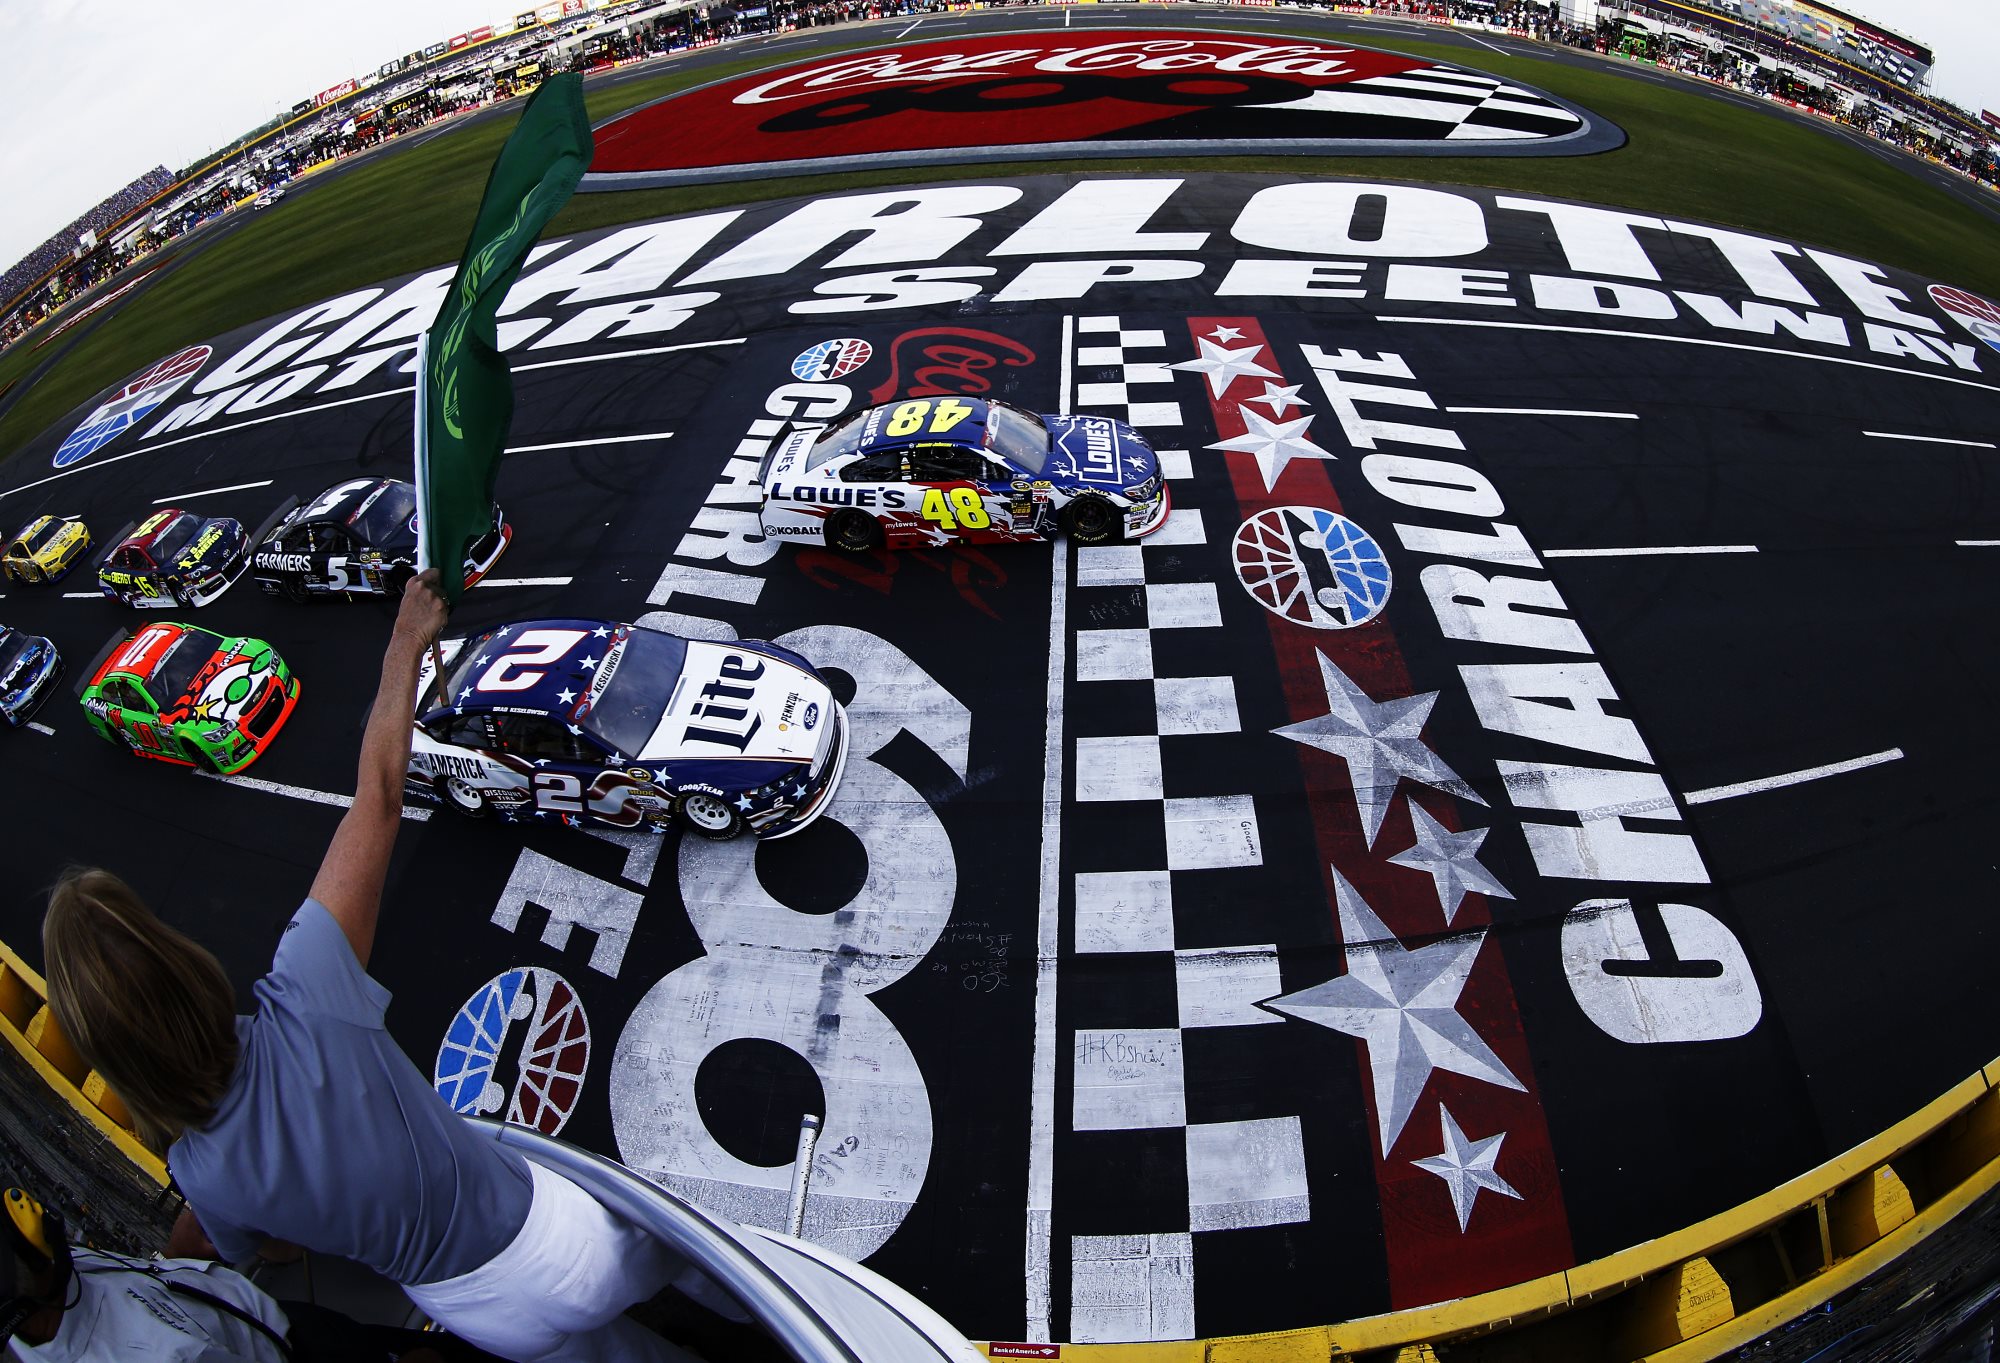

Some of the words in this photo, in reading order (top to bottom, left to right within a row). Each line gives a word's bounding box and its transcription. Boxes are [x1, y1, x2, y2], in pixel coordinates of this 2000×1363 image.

[731, 40, 1356, 105] Coca-Cola
[322, 80, 354, 104] Coca-Cola
[787, 258, 1984, 373] SPEEDWAY
[861, 404, 889, 447] LOWE'S
[885, 399, 974, 437] 48
[1083, 419, 1114, 474] LOWE'S
[770, 482, 906, 509] LOWE'S
[920, 487, 993, 531] 48
[1033, 494, 1048, 503] 3M
[195, 529, 224, 561] ENERGY
[776, 526, 822, 536] KOBALT
[221, 549, 240, 571] CAMRY
[255, 552, 312, 572] FARMERS
[327, 556, 349, 591] 5
[111, 572, 131, 585] ENERGY
[134, 576, 160, 598] 15
[0, 644, 40, 691] FedEx
[26, 650, 42, 666] Office
[219, 638, 249, 668] GoDaddy
[476, 628, 592, 693] 2
[490, 382, 853, 980] CHARLE
[593, 649, 622, 695] KESELOWSKI
[680, 654, 766, 755] Lite
[780, 691, 799, 723] PENNZOIL
[1300, 343, 1764, 1044] CHARLOTTE
[509, 707, 550, 716] KESELOWSKI
[132, 721, 161, 750] 10
[428, 753, 489, 780] AMERICA
[483, 789, 523, 798] DISCOUNT
[534, 773, 584, 814] 2
[628, 789, 655, 797] MOOG
[678, 783, 725, 797] GOODYEAR
[773, 796, 784, 809] 2
